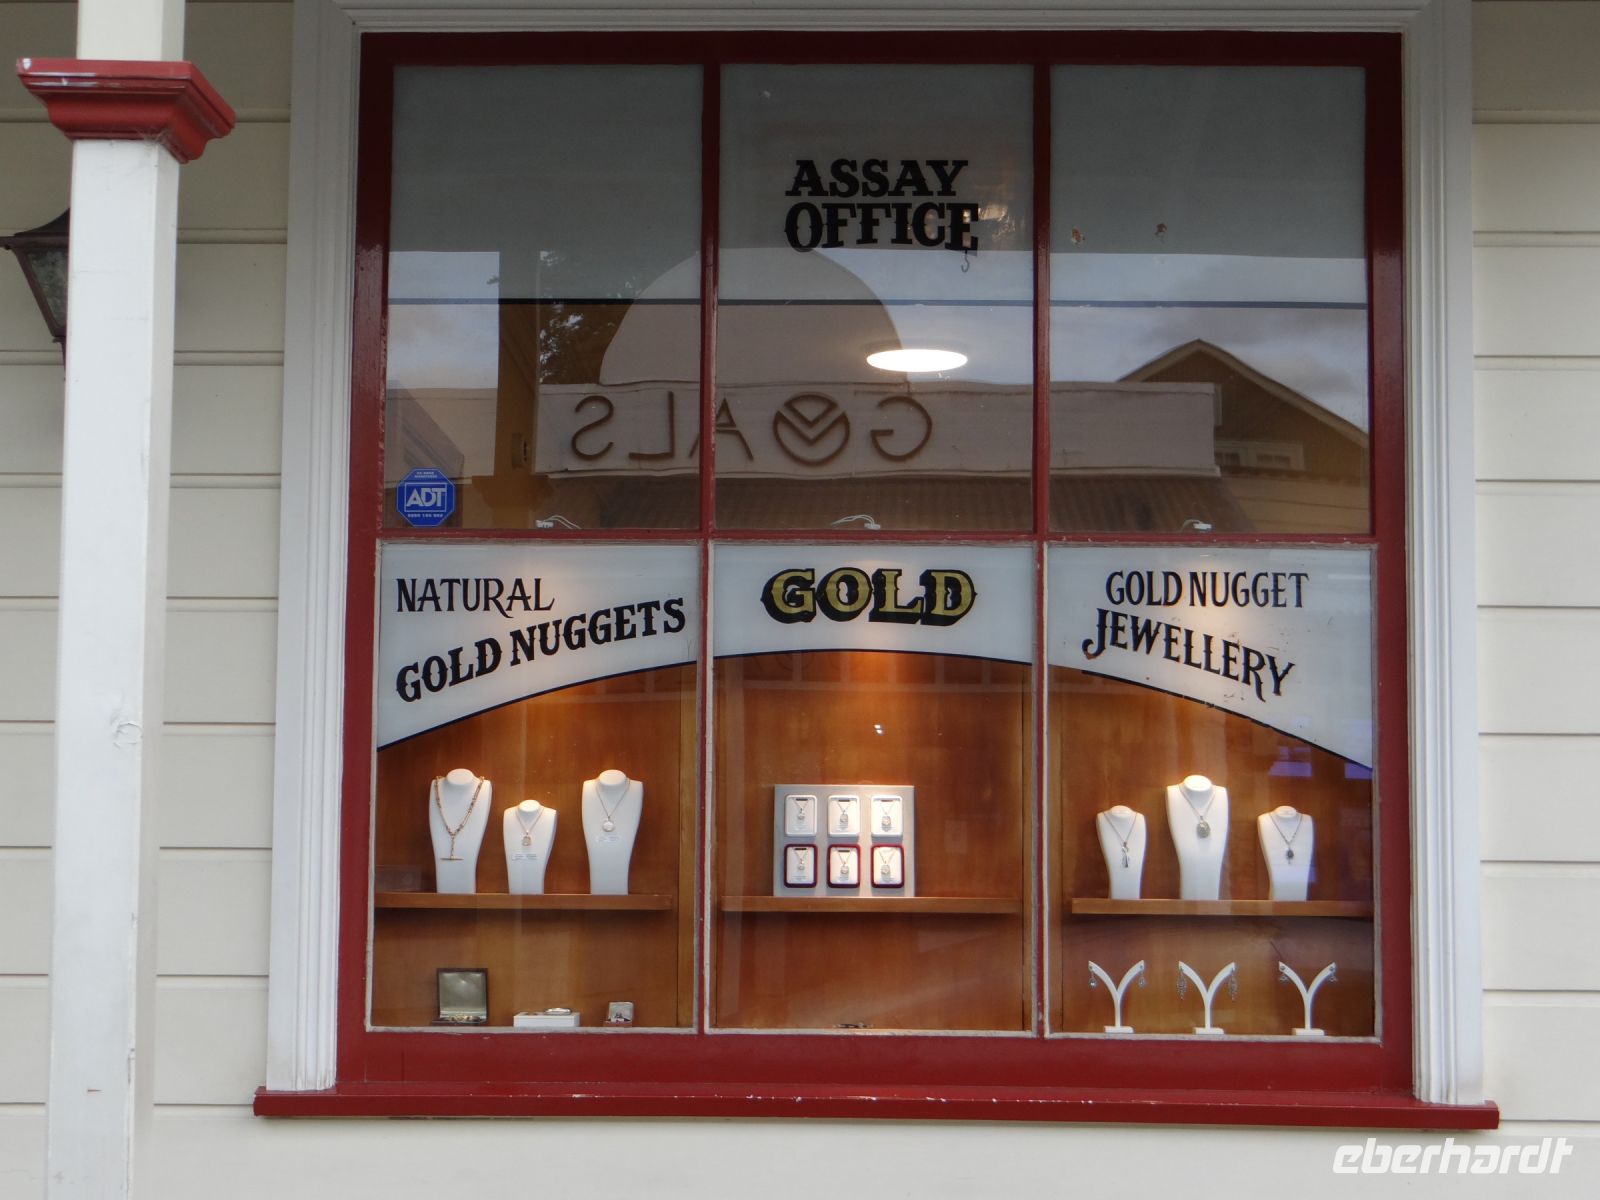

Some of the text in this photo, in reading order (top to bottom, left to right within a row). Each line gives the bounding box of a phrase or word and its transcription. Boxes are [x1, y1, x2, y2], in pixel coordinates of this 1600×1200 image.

[785, 158, 969, 198] ASSAY
[784, 202, 979, 256] OFFICE
[406, 487, 447, 507] ADT
[396, 578, 555, 618] NATURAL
[760, 567, 977, 626] GOLD
[1105, 570, 1309, 608] GOLD NUGGET
[396, 597, 686, 702] GOLD NUGGETS
[1081, 608, 1296, 702] JEWELLERY
